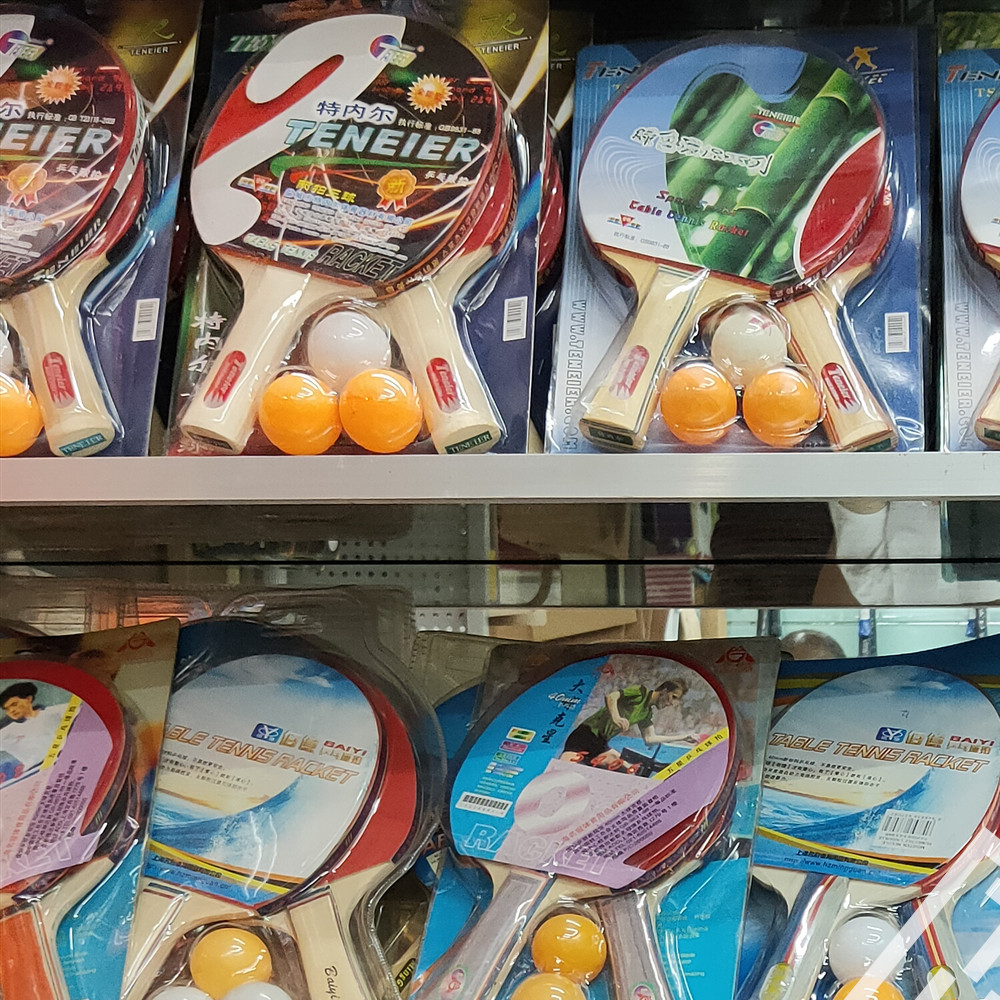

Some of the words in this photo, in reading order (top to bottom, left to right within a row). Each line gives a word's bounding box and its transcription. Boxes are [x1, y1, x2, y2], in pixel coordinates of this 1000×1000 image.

[316, 99, 395, 122] 特内尔
[284, 119, 484, 162] TENEIER
[317, 243, 405, 281] RACKET
[541, 677, 588, 745] 大克星
[207, 735, 279, 764] TENNIS
[271, 752, 360, 785] RACKET
[323, 740, 368, 756] BAIYI
[768, 732, 833, 754] TABLE
[830, 741, 905, 762] TENNIS
[900, 751, 991, 775] RACKET
[949, 734, 996, 747] BAIYI
